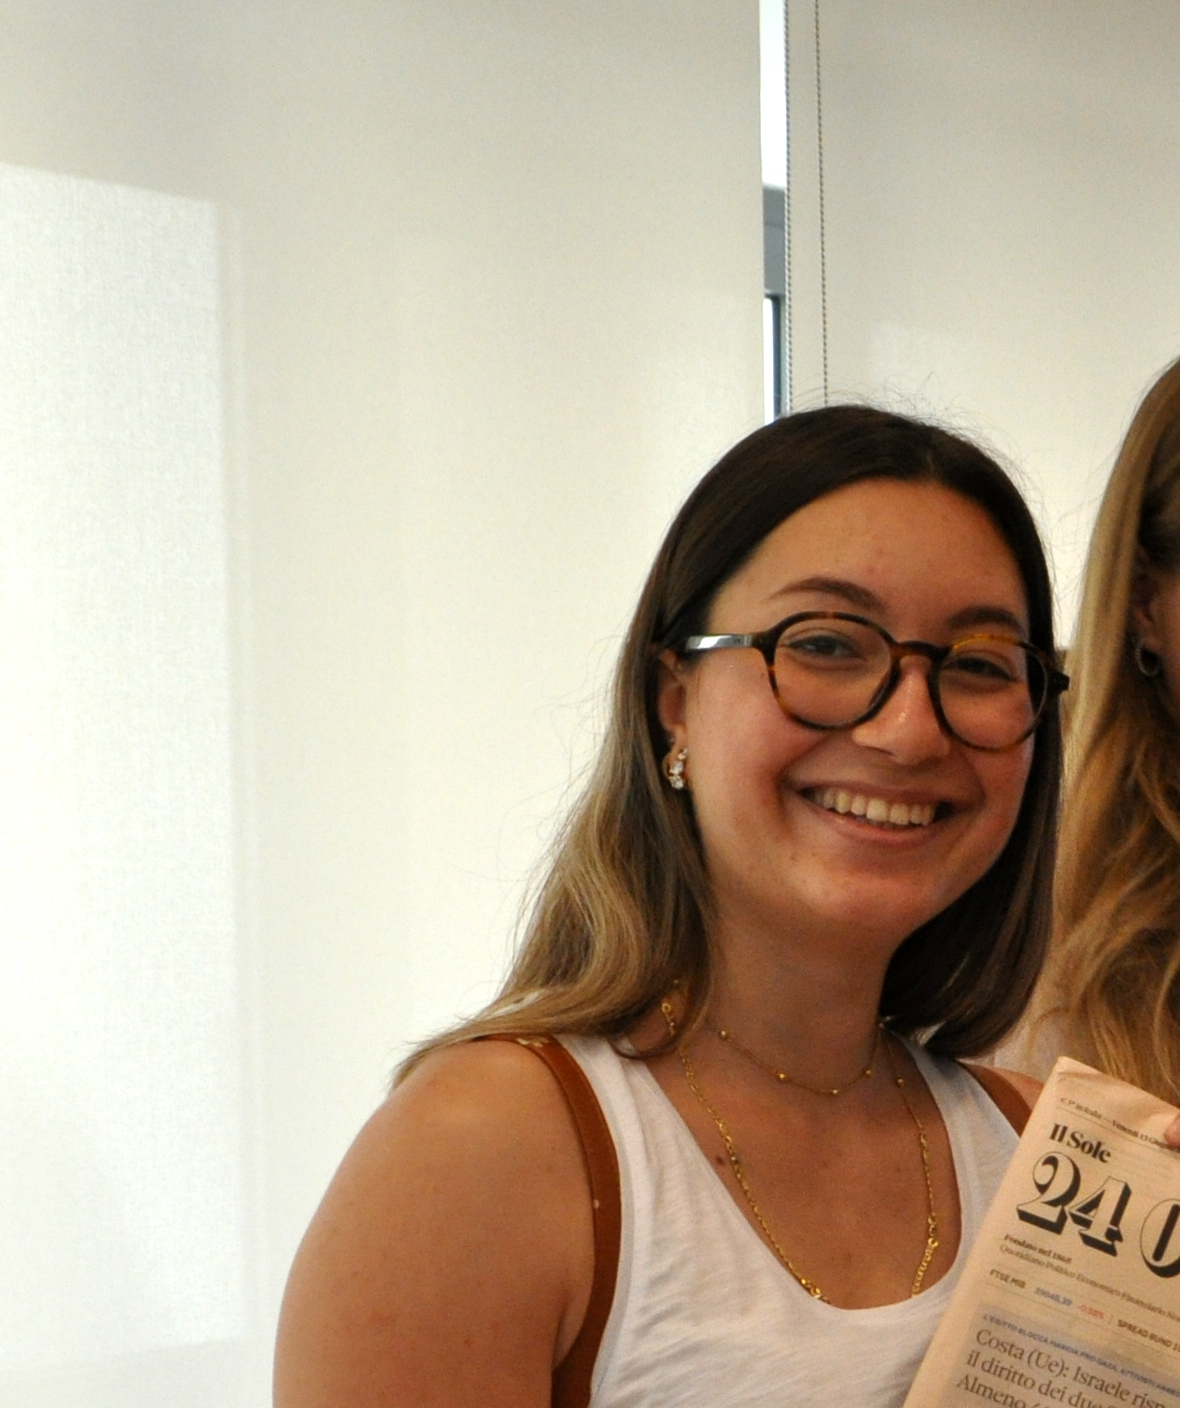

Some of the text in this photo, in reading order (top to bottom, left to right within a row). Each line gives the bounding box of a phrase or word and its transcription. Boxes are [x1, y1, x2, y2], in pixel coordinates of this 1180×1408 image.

[1049, 1123, 1111, 1163] Il Sole
[1016, 1155, 1132, 1257] 24
[989, 1269, 1026, 1289] FTSE MIB
[966, 1350, 981, 1368] il
[981, 1357, 1036, 1390] diritto
[1037, 1379, 1068, 1402] dei
[976, 1329, 1025, 1361] Costa
[1027, 1349, 1070, 1378] (Ue):
[1072, 1366, 1131, 1402] Israele
